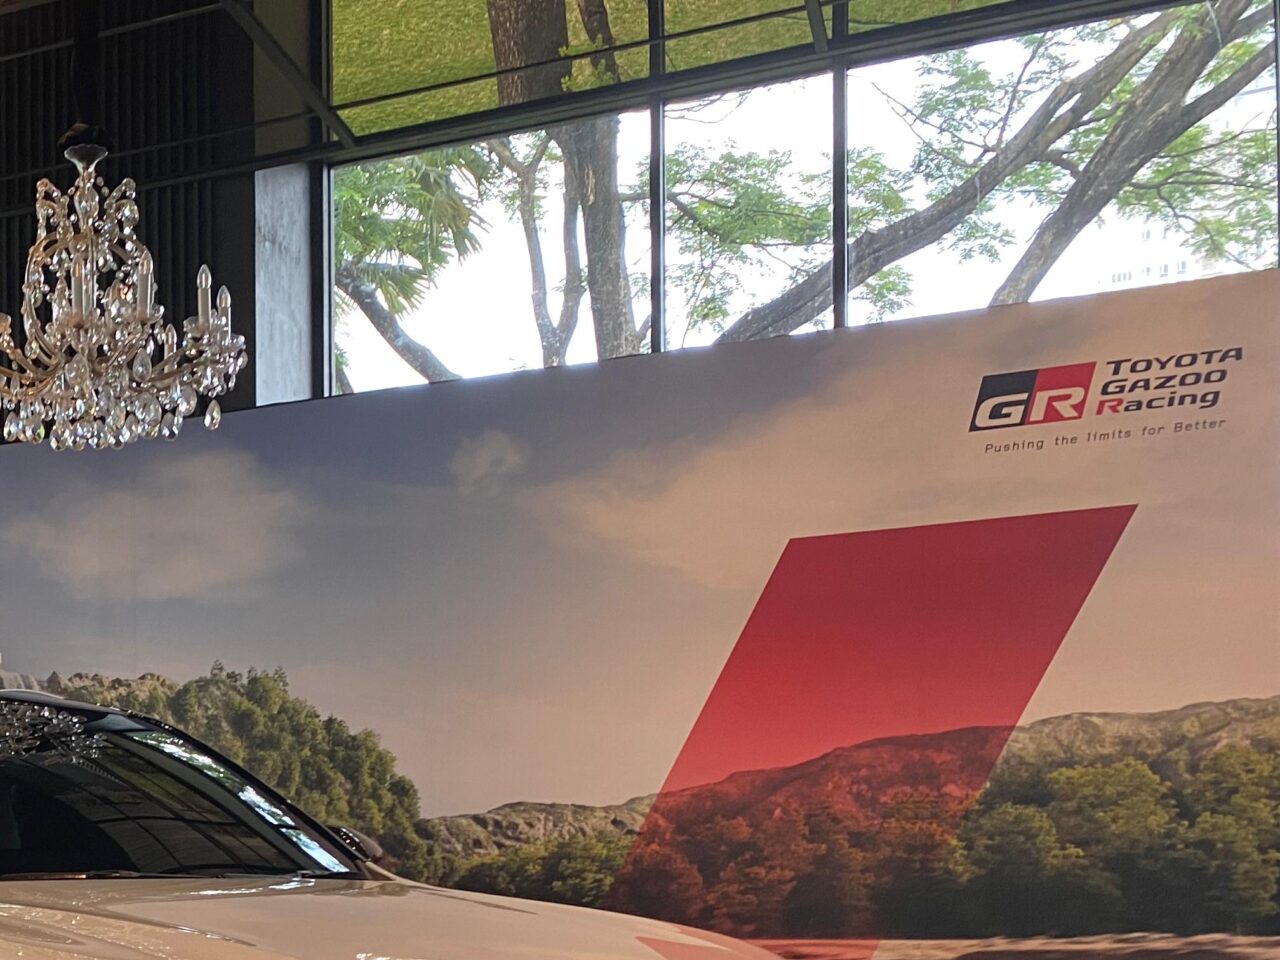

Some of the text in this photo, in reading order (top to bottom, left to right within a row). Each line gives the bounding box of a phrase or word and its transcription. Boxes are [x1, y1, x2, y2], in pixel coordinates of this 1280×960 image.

[1106, 346, 1244, 376] TOYOTA
[1100, 369, 1228, 396] GAZOO
[1095, 390, 1221, 416] Racing
[984, 417, 1227, 454] Pushing the limits for Better
